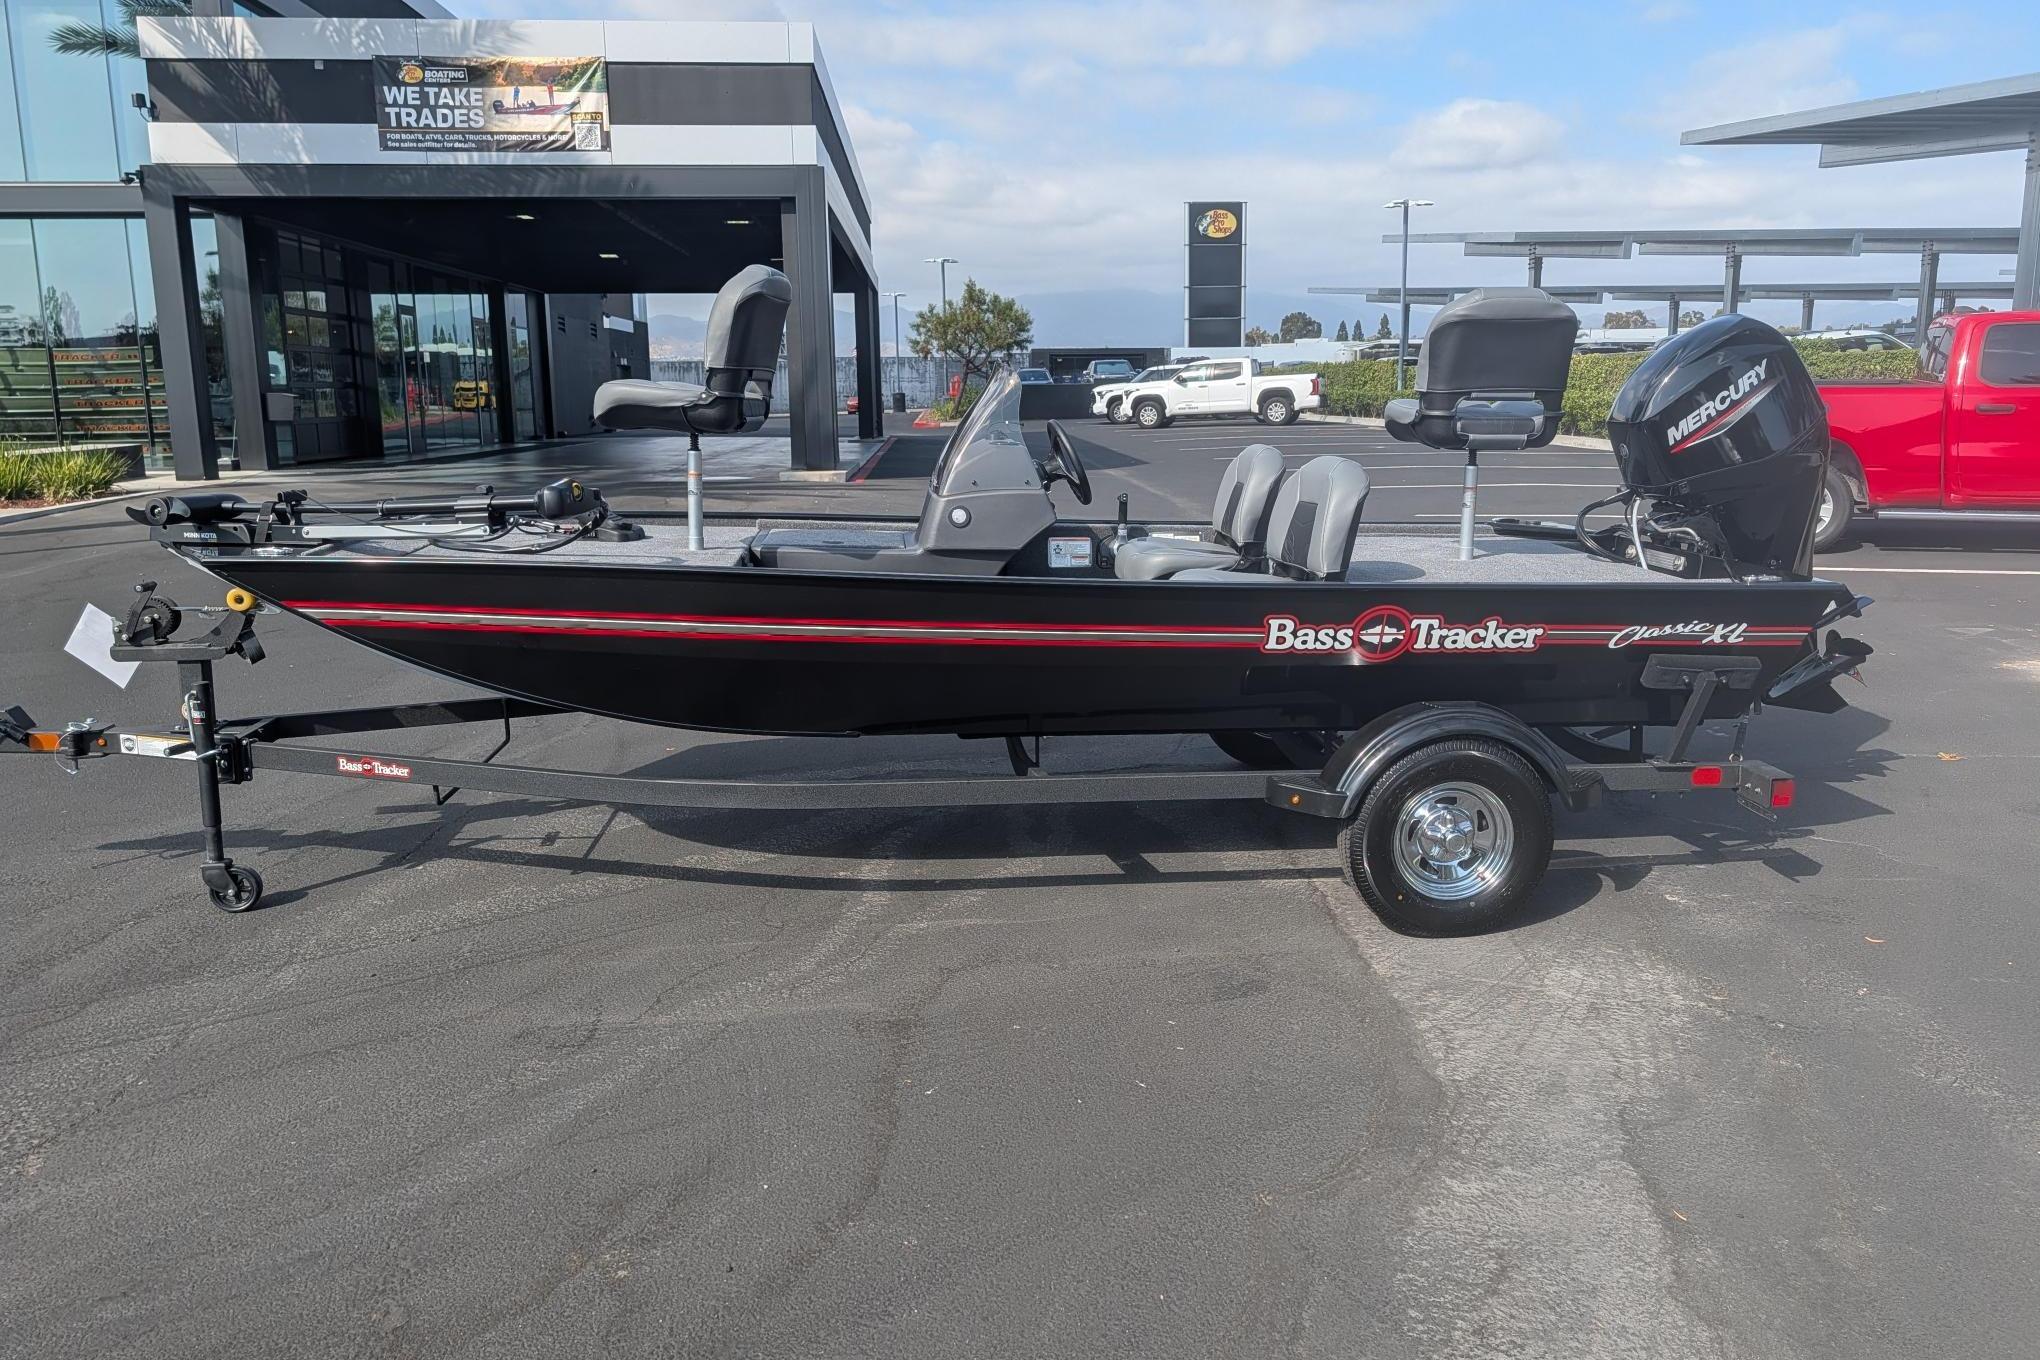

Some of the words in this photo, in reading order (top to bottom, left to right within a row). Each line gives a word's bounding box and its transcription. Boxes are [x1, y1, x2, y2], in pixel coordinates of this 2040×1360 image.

[424, 70, 465, 79] BOATING
[382, 86, 421, 105] WE
[424, 87, 484, 106] TAKE
[384, 107, 485, 128] TRADES
[401, 133, 424, 141] BOATS,
[465, 134, 494, 142] TRUCKS,
[1212, 211, 1228, 219] Bass
[1212, 226, 1232, 234] Shops
[1666, 358, 1768, 446] MERCURY
[1264, 618, 1354, 650] Bass
[1411, 616, 1544, 650] Tracker
[1608, 620, 1714, 649] Classic
[1702, 622, 1748, 644] XL
[338, 758, 363, 772] Bass
[371, 761, 410, 776] Tracker
